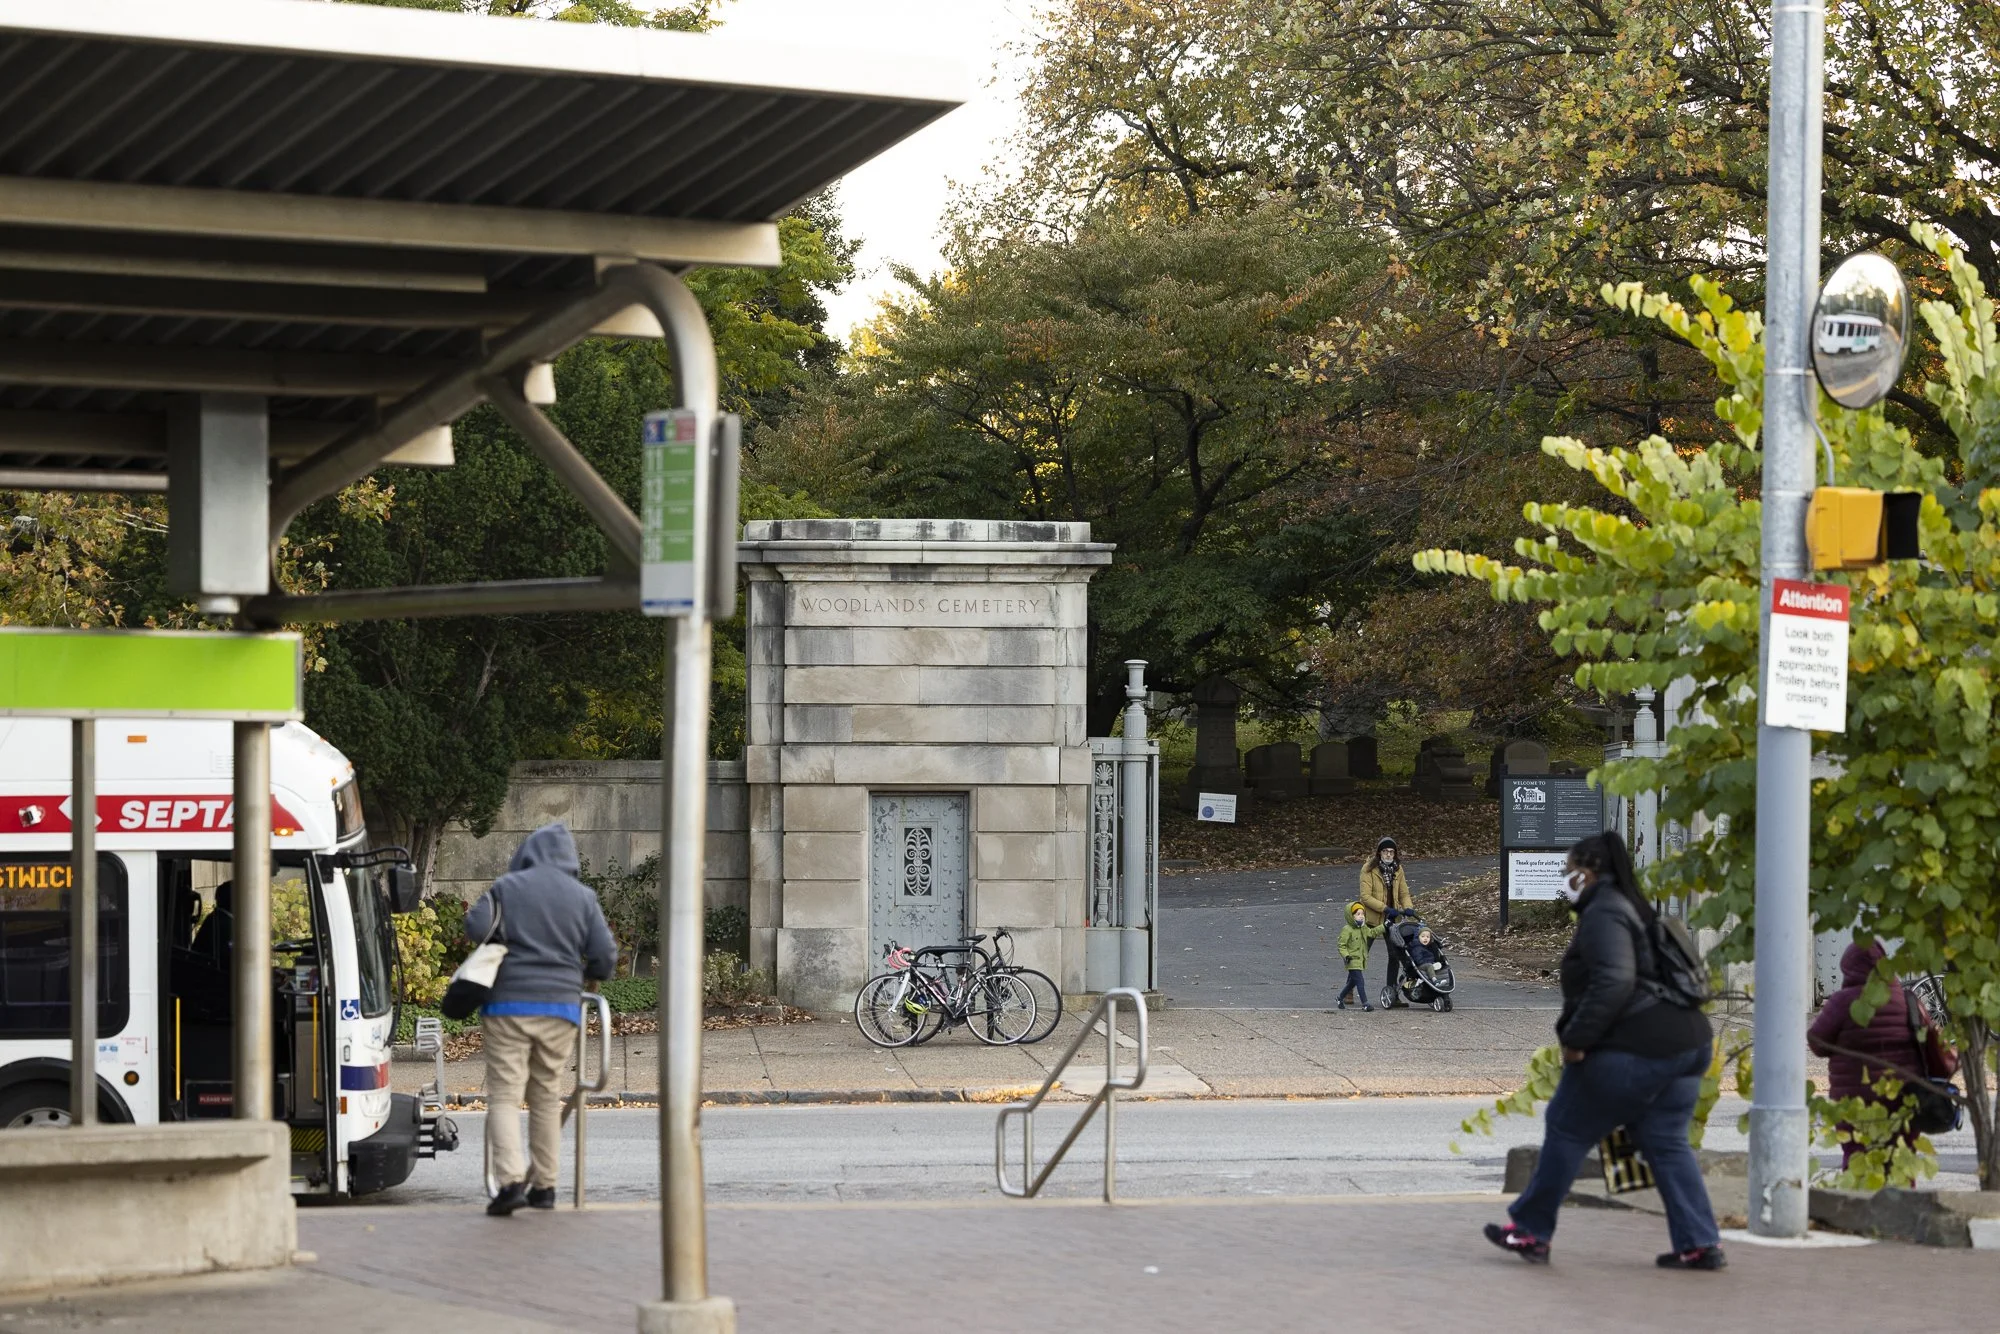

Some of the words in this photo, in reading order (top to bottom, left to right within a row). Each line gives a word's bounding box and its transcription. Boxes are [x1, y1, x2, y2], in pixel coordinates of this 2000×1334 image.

[802, 598, 925, 613] WOODLANDS
[938, 598, 1041, 614] CEMETERY
[1779, 589, 1842, 613] Attention
[1784, 627, 1808, 639] Look
[1812, 629, 1834, 642] both
[1789, 645, 1812, 657] ways
[1816, 647, 1829, 657] for
[1778, 660, 1839, 676] approaching
[1775, 673, 1806, 689] Trolley
[1810, 678, 1840, 690] before
[1786, 692, 1828, 708] crossing
